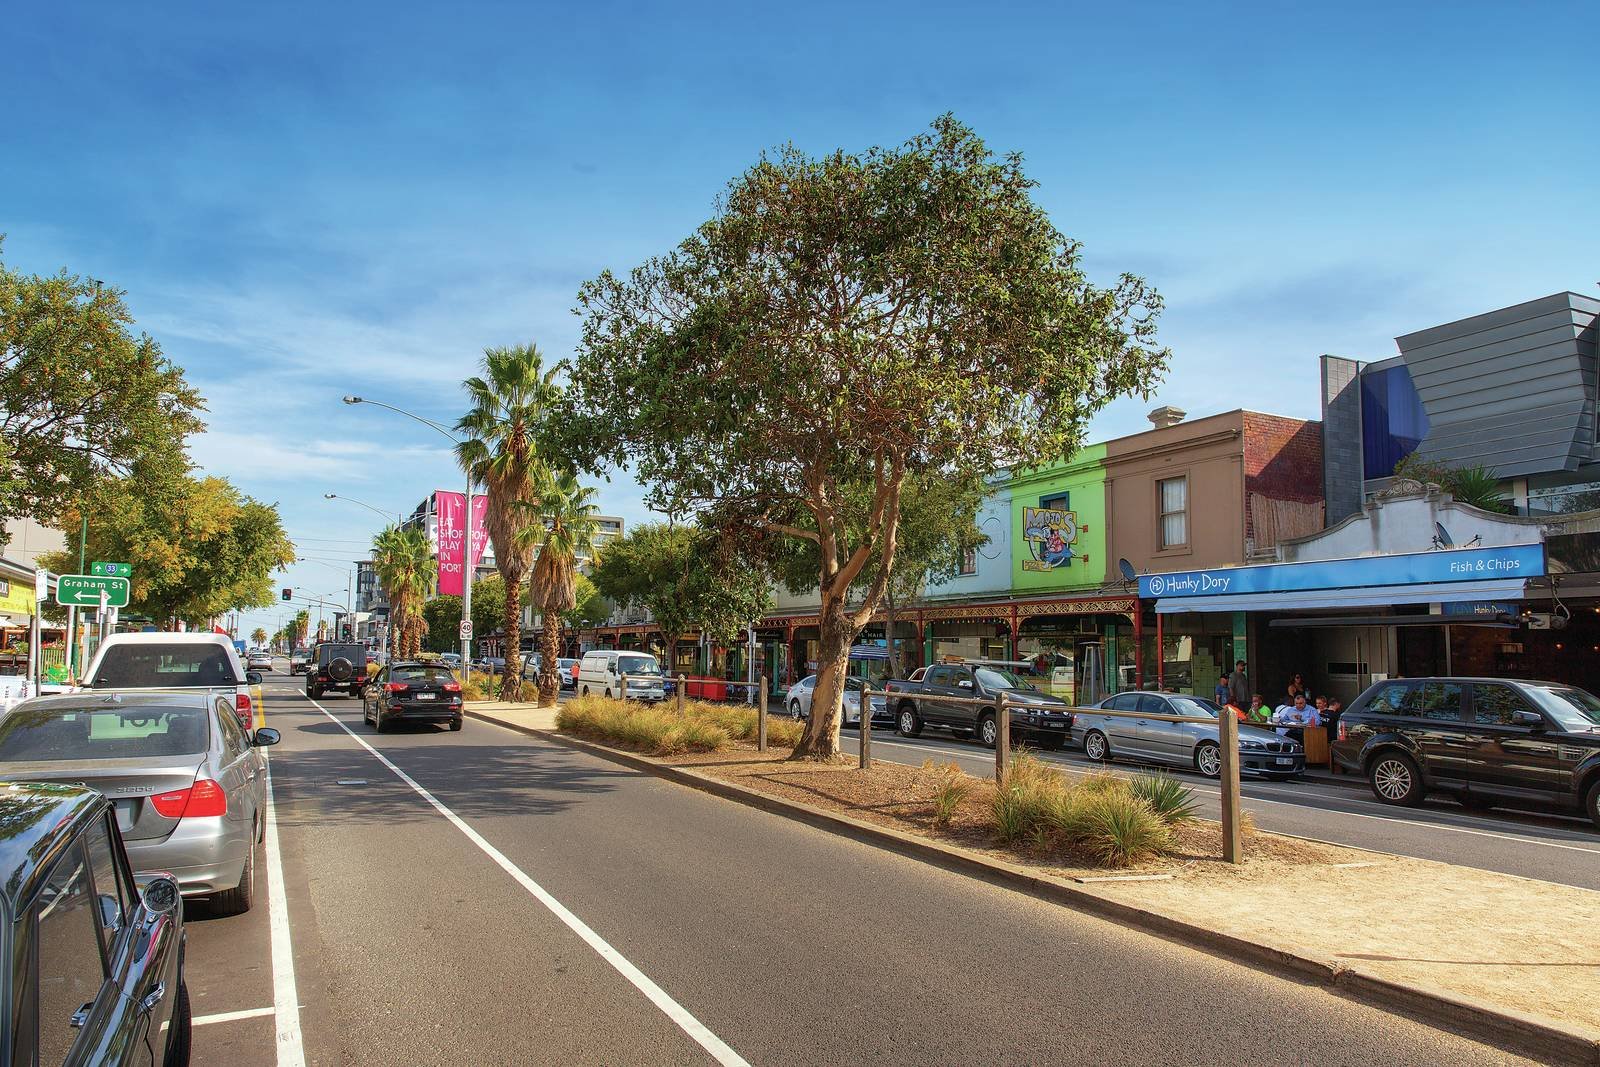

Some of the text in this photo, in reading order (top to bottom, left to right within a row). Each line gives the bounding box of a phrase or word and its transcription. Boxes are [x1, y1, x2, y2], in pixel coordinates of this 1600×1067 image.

[440, 517, 454, 529] EAT
[440, 529, 463, 539] SHOP
[440, 540, 460, 550] PLAY
[440, 551, 451, 561] IN
[441, 562, 461, 573] PORT
[1450, 558, 1520, 573] Fish & Chips
[63, 579, 123, 589] Graham St
[1166, 573, 1231, 593] Hunky Dory
